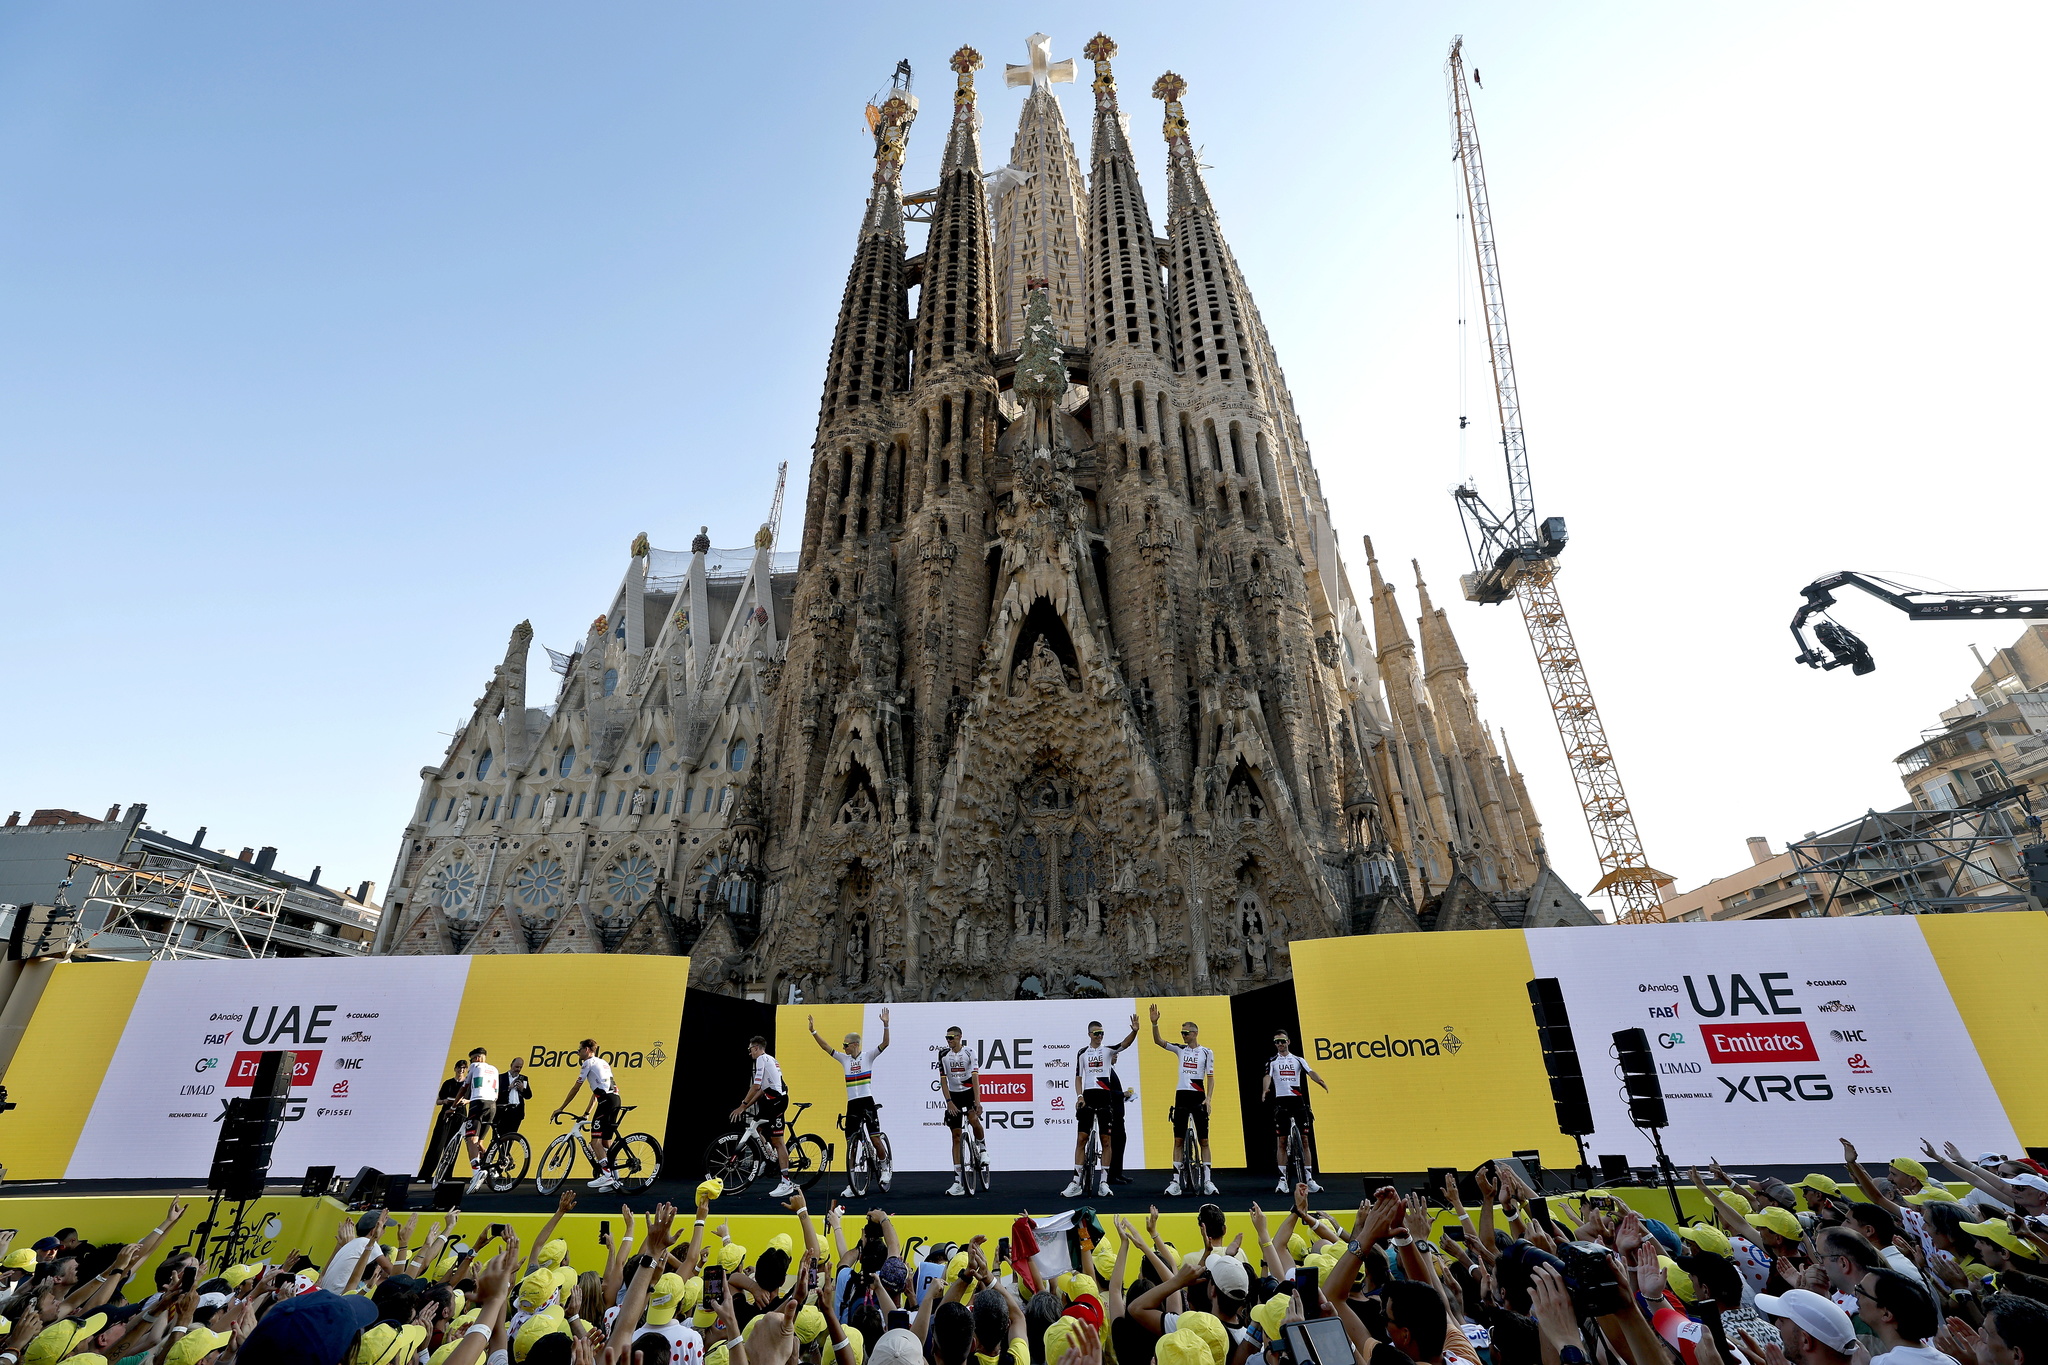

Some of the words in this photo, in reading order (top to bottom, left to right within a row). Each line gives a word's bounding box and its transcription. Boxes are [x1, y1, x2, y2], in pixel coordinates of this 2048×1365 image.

[1647, 983, 1679, 993] Analog
[1813, 979, 1847, 987] COLNAGO
[1683, 972, 1802, 1017] UAE
[1817, 1003, 1856, 1013] WHOOSH
[217, 1013, 243, 1022] Analog
[242, 1005, 338, 1045] UAE
[1658, 1032, 1686, 1049] G42
[1711, 1032, 1804, 1053] Emirates
[1842, 1030, 1867, 1042] IHC
[1314, 1034, 1440, 1060] Barcelona
[344, 1058, 364, 1069] IHC
[529, 1046, 643, 1068] Barclona
[195, 1058, 218, 1073] G42
[1660, 1062, 1702, 1075] L'IMAD
[979, 1081, 1026, 1094] mirates
[1054, 1080, 1069, 1089] IHC
[1717, 1074, 1833, 1103] XRG
[1859, 1085, 1892, 1094] PISSEI
[926, 1101, 947, 1109] L'IMA
[985, 1110, 1034, 1130] RG
